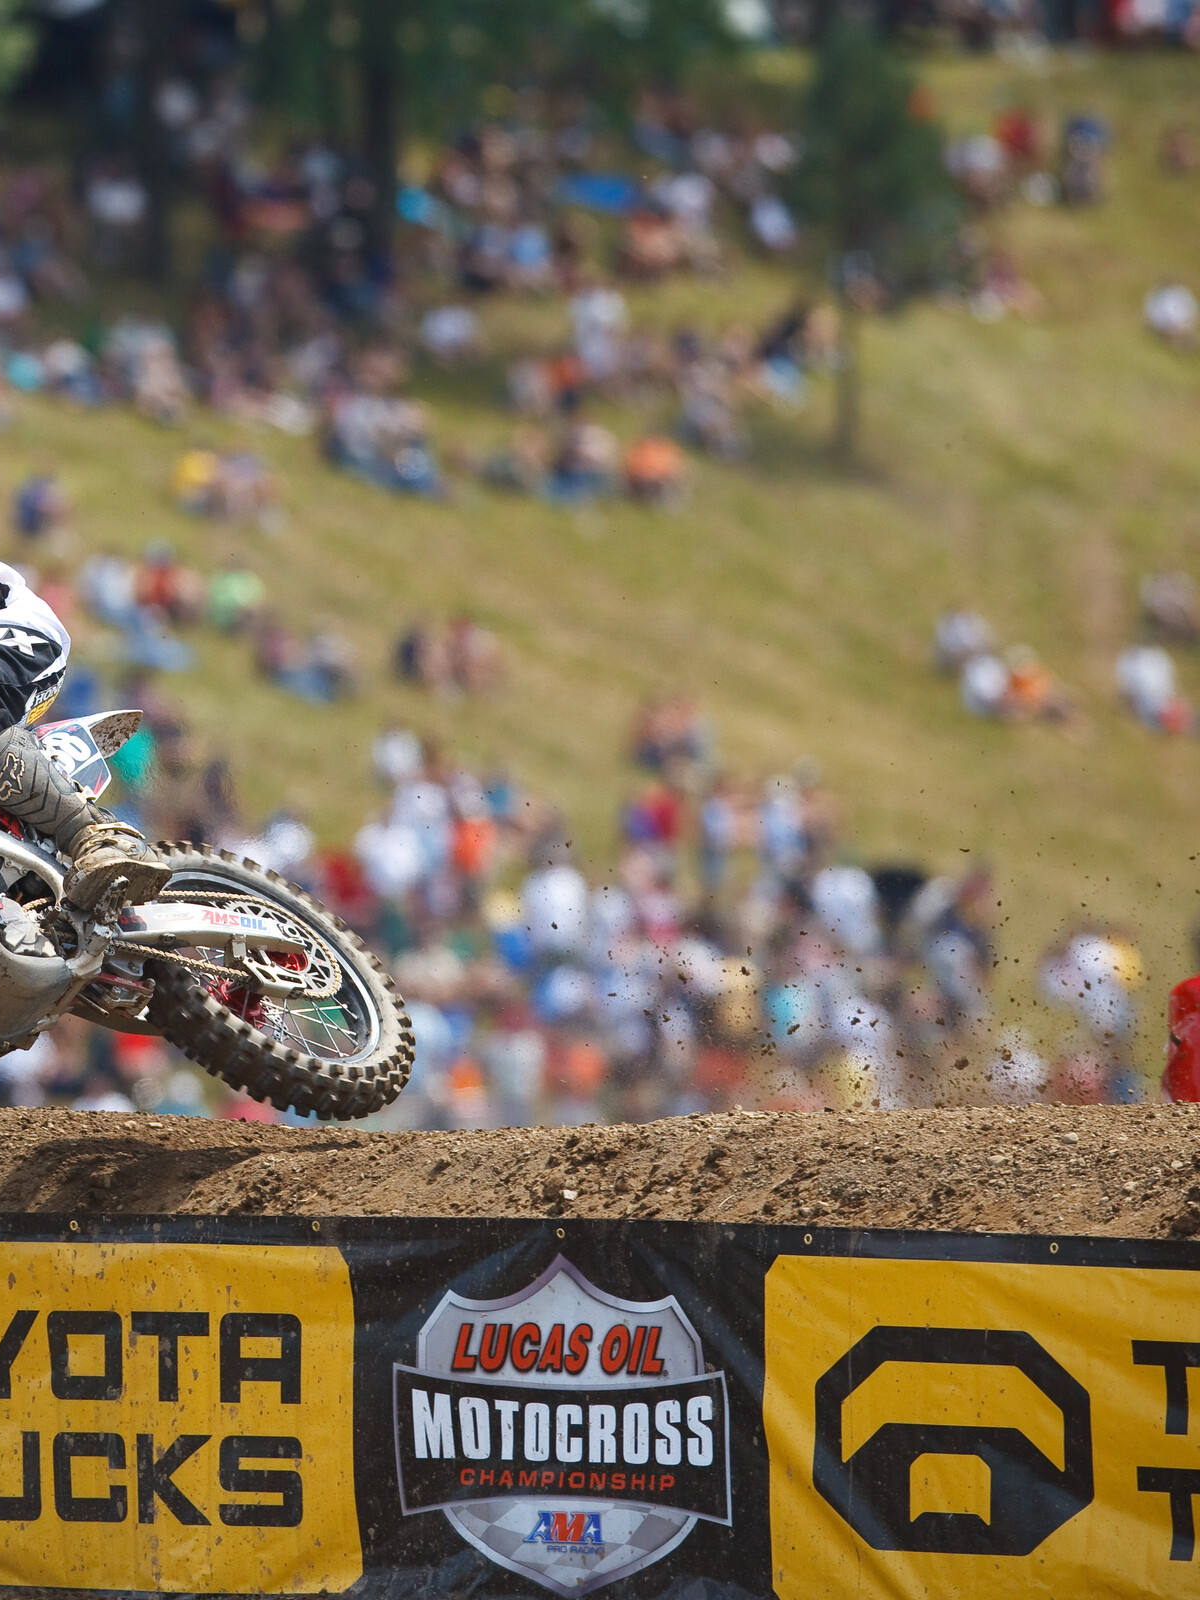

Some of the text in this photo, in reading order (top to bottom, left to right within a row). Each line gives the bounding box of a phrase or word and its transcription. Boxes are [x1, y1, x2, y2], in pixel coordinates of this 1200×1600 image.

[201, 909, 267, 931] AMSOIL
[451, 1322, 665, 1375] LUCAS OIL
[411, 1388, 714, 1467] MOTOCROSS
[460, 1468, 676, 1491] CHAMPIONSHIP
[523, 1510, 605, 1544] AMA
[546, 1545, 606, 1555] PRO RACING
